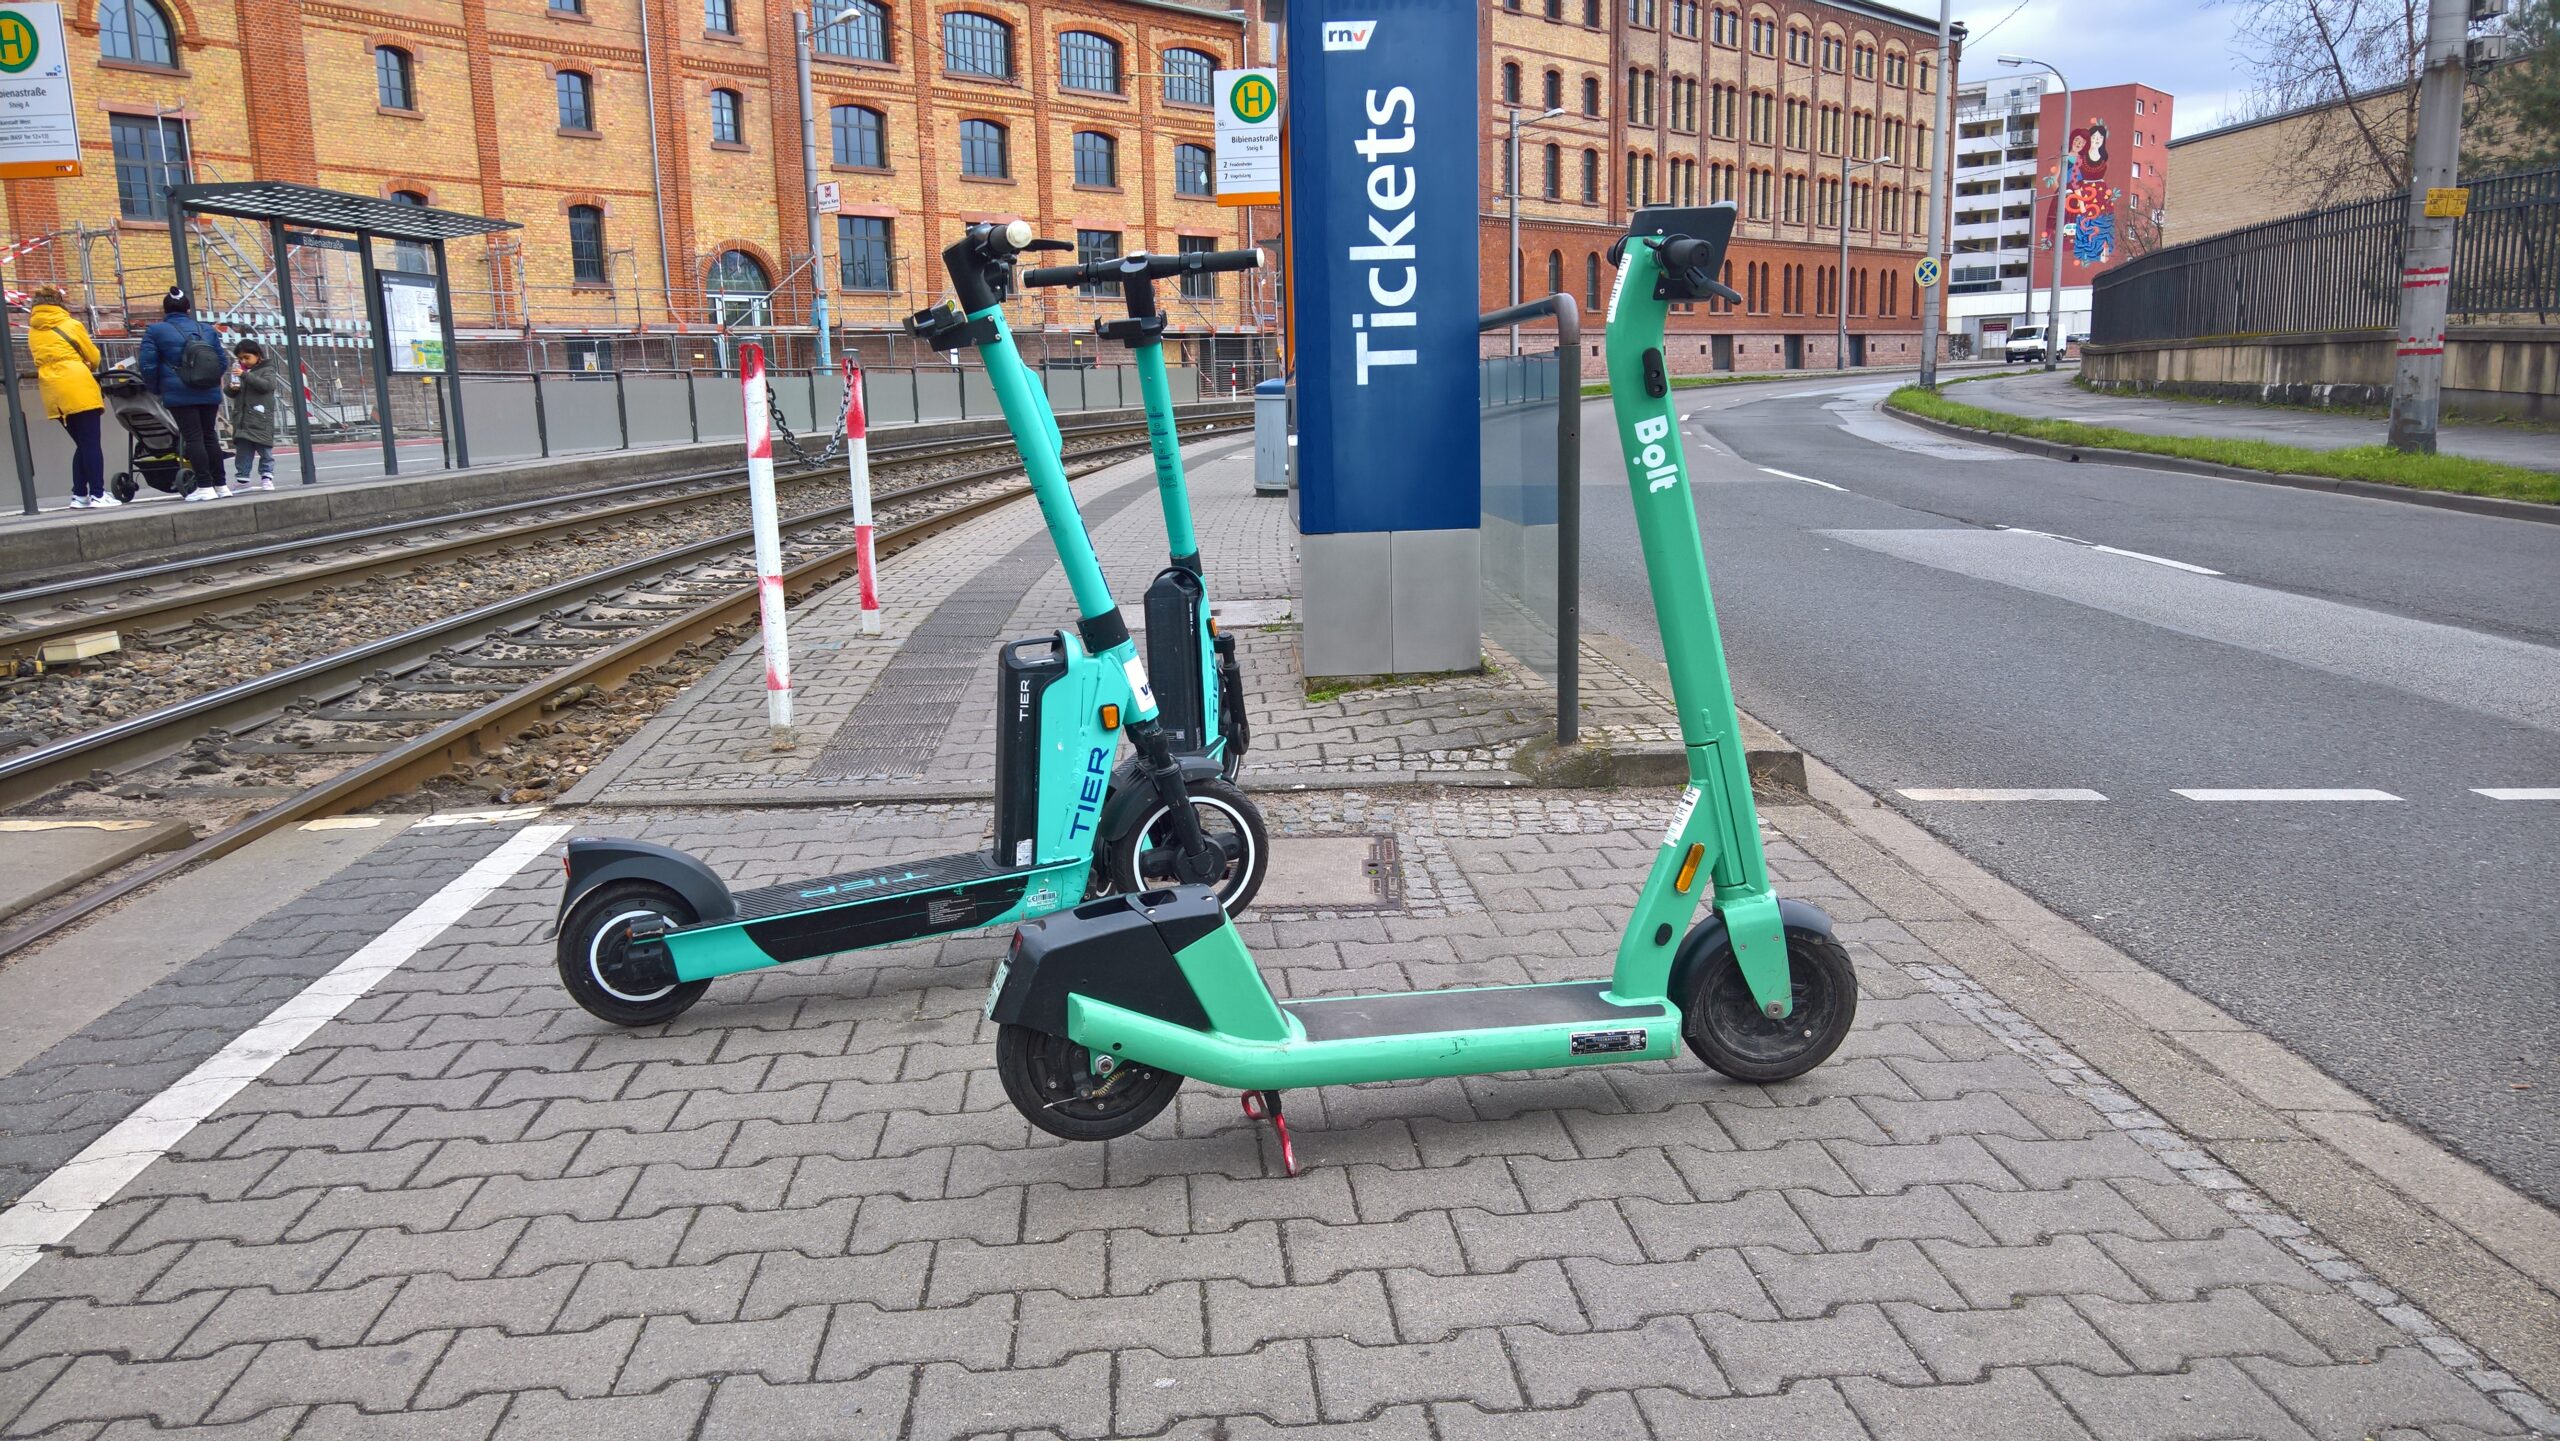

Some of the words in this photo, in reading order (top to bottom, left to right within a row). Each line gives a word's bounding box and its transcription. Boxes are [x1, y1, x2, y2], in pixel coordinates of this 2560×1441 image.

[0, 24, 24, 59] H
[1328, 29, 1366, 42] rnv
[1243, 85, 1263, 113] H
[1231, 133, 1278, 144] Bibienastraße
[302, 235, 344, 250] Bibienastraße
[1349, 85, 1418, 385] Tickets
[1633, 414, 1679, 494] Bolt
[1019, 679, 1030, 722] TIER
[1069, 747, 1109, 840] TIER
[799, 872, 930, 898] TIER
